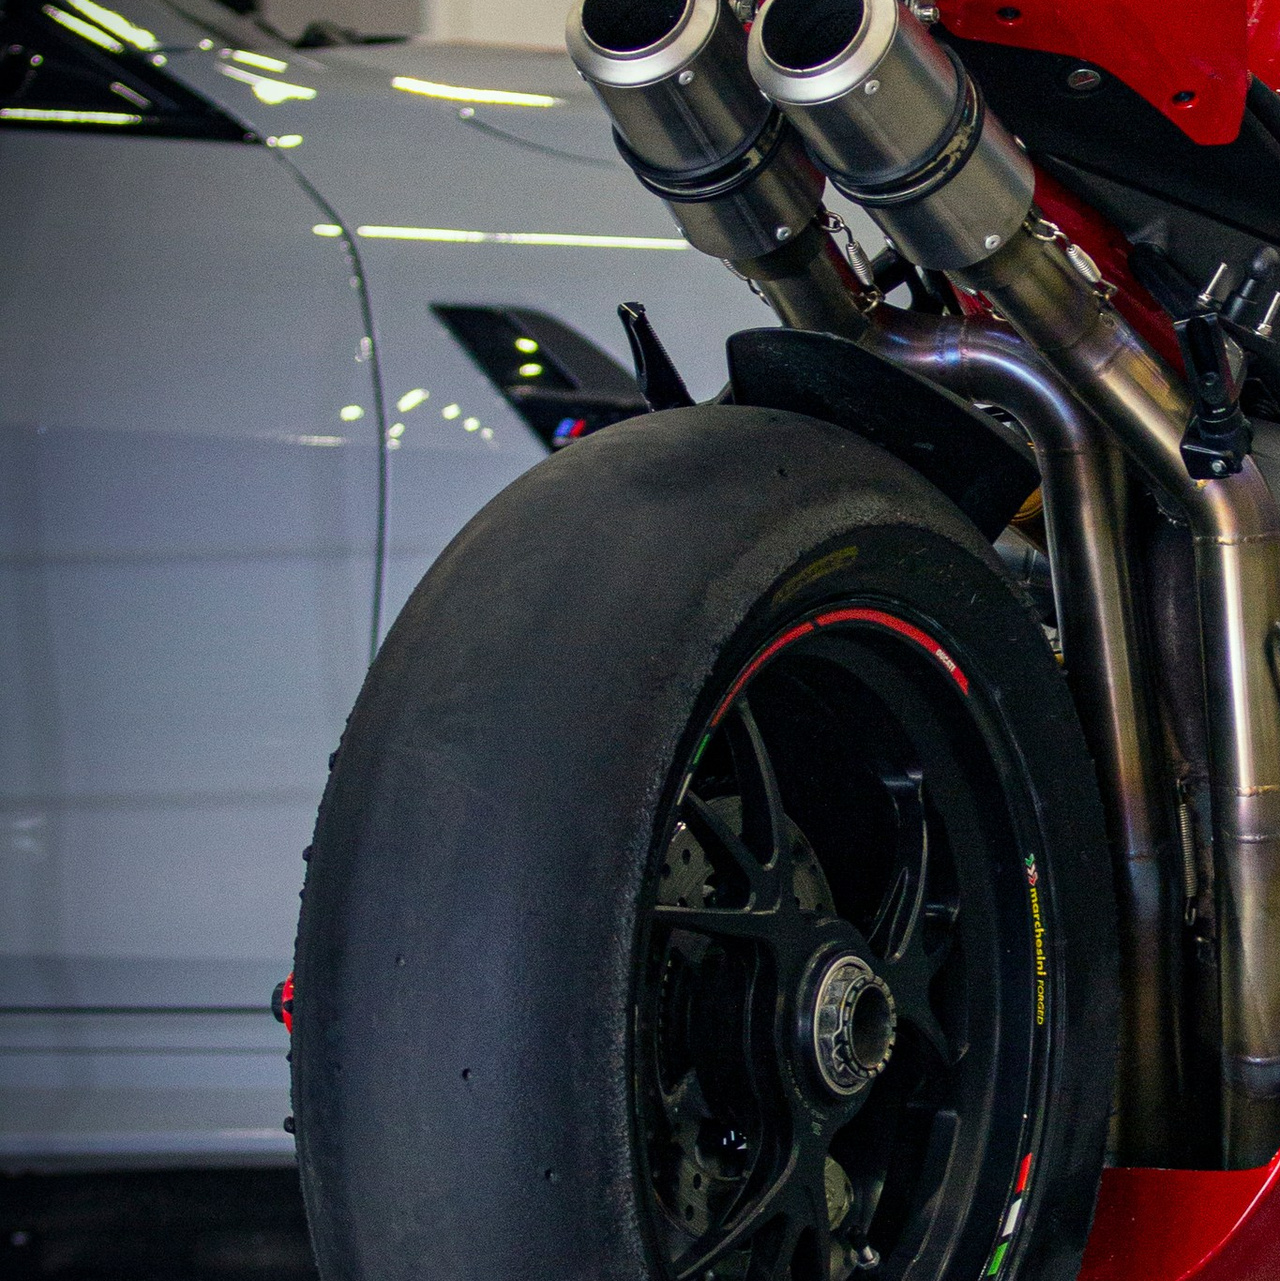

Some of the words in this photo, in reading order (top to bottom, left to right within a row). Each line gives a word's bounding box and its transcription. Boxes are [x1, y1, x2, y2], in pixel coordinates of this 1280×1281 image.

[935, 648, 956, 672] DUCATI
[1029, 887, 1047, 976] marchesini
[1036, 979, 1046, 1026] FORGED
